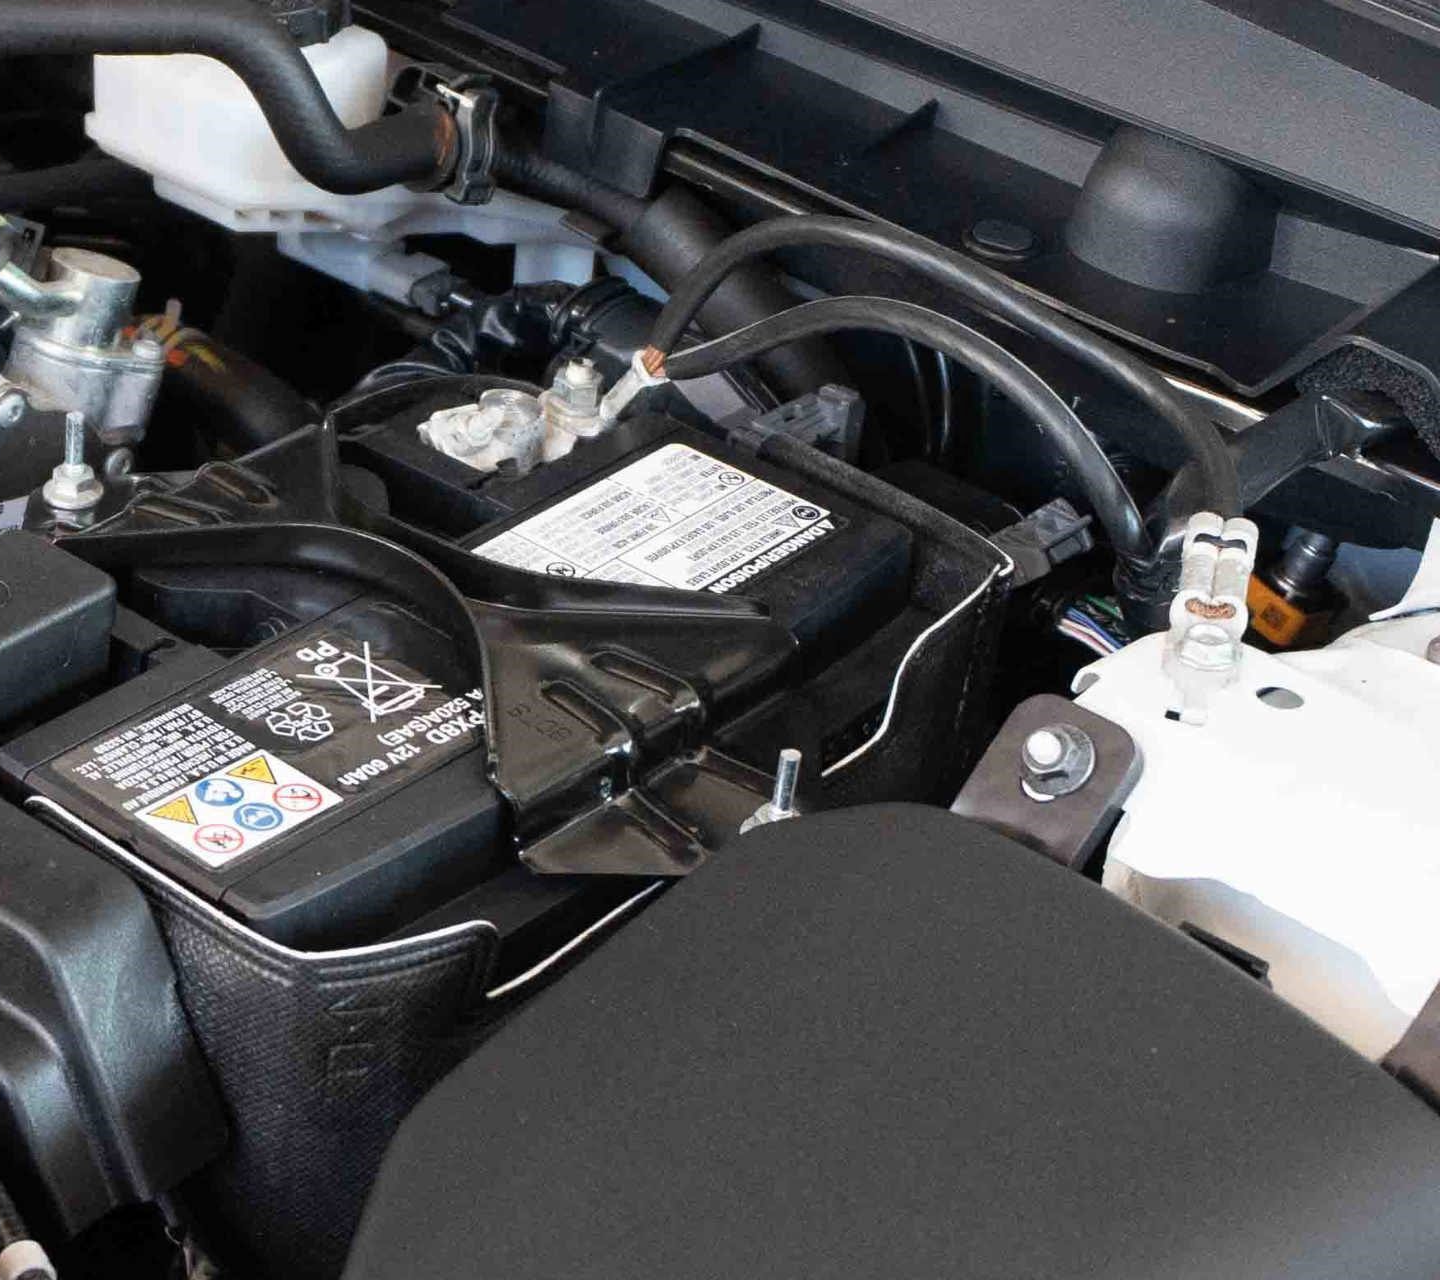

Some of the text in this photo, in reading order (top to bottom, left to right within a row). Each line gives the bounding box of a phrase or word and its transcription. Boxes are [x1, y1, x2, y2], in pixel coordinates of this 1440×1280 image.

[706, 526, 827, 593] DANGER/POISON
[296, 639, 340, 662] Pb
[162, 718, 185, 730] PAR
[376, 697, 470, 745] 520A(SAE)
[119, 730, 138, 740] WI
[184, 722, 223, 742] TOYOTA
[211, 729, 234, 741] FOR
[179, 741, 210, 757] POUR
[224, 742, 255, 758] MADE
[386, 743, 421, 763] 12V
[176, 752, 212, 770] HECHO
[213, 755, 229, 764] IN
[84, 771, 102, 780] AL
[112, 769, 152, 789] MAZDA
[162, 767, 181, 777] EN
[336, 759, 389, 783] 60Ah
[134, 774, 167, 790] U.S.A.
